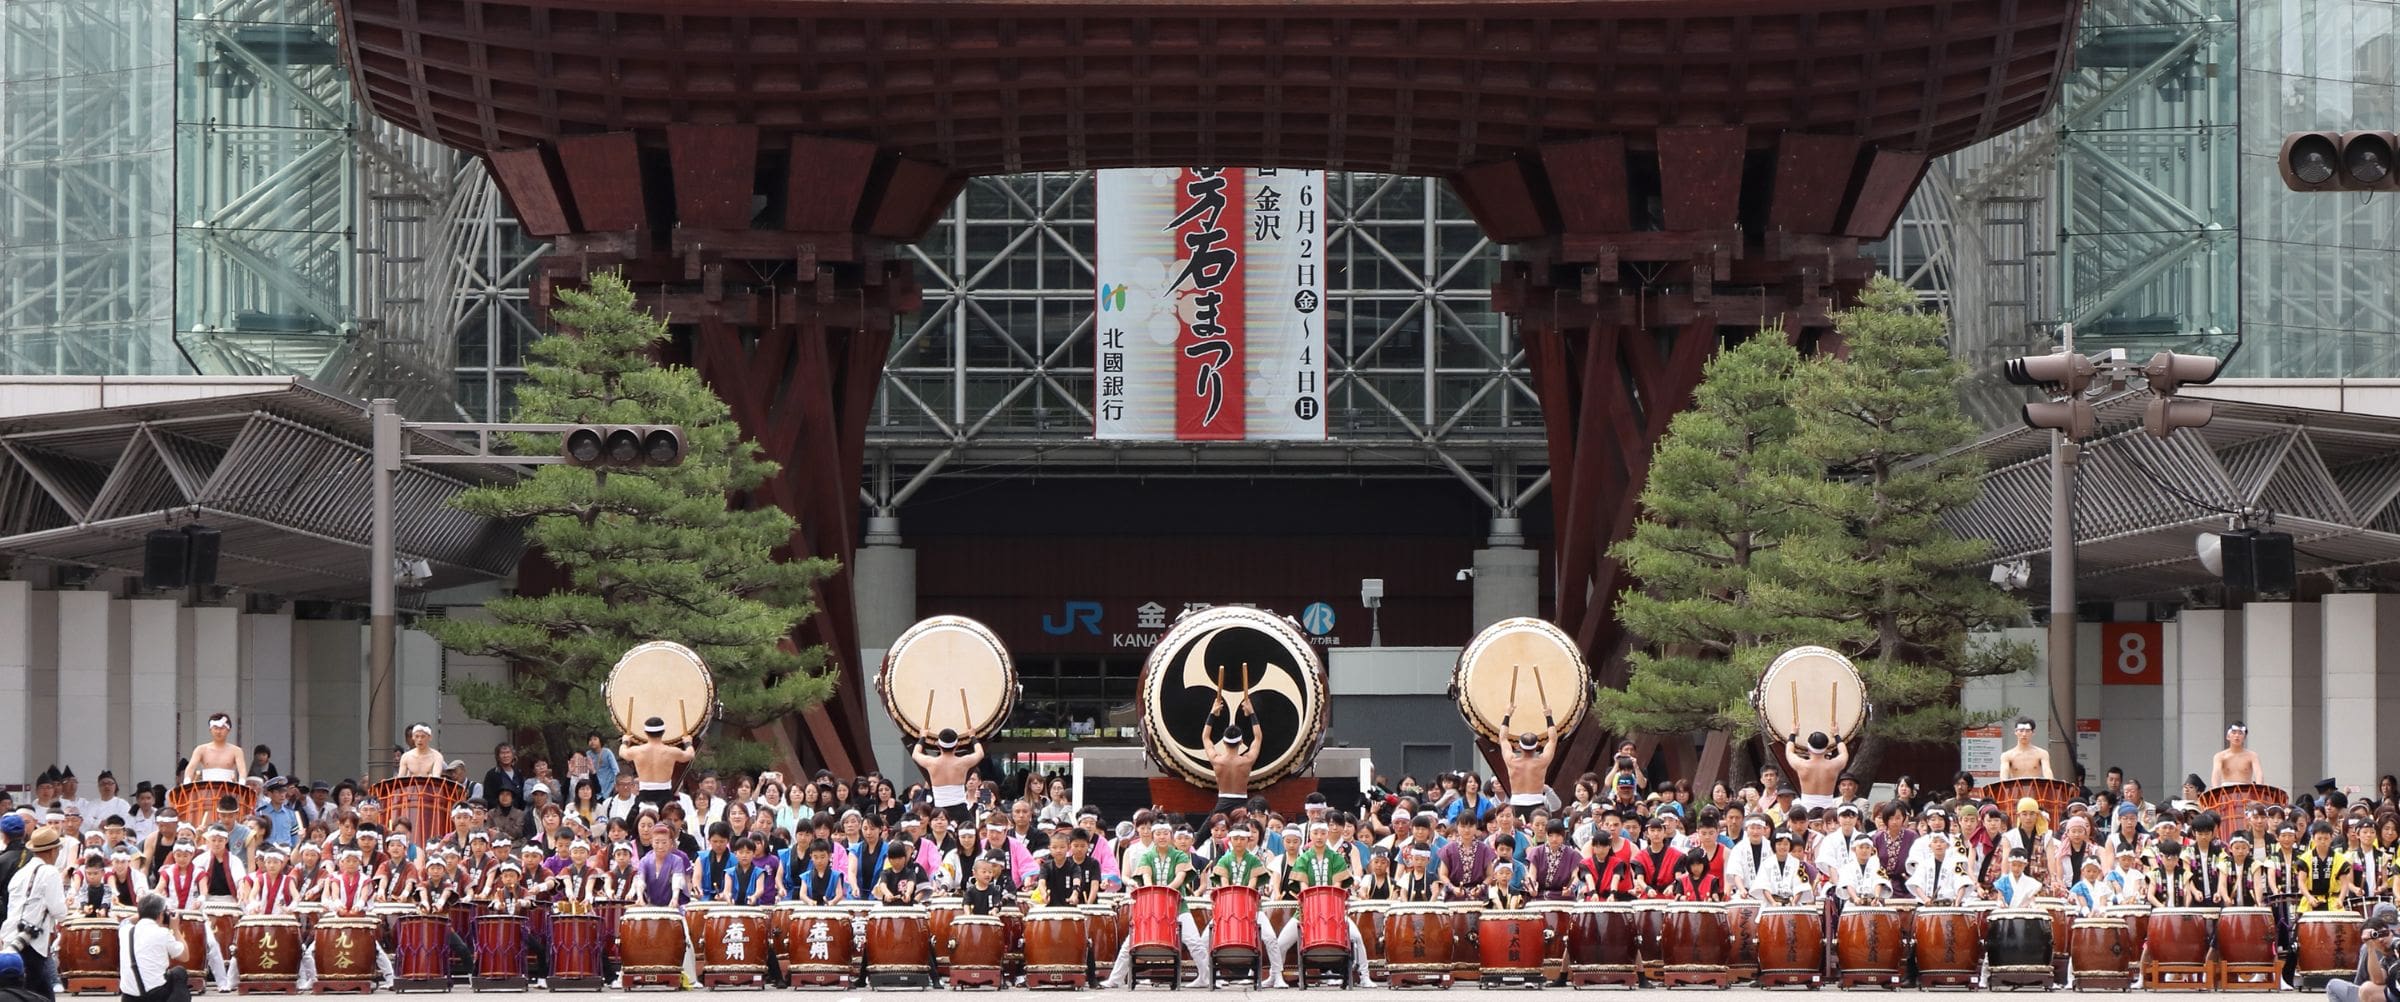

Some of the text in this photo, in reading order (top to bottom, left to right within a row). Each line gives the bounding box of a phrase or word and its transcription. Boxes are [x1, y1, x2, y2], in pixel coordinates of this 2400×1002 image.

[1102, 328, 1124, 421] 北國銀行
[1042, 601, 1104, 636] JR
[2117, 632, 2147, 675] 8
[259, 931, 279, 969] 九谷
[335, 931, 354, 969] 九谷
